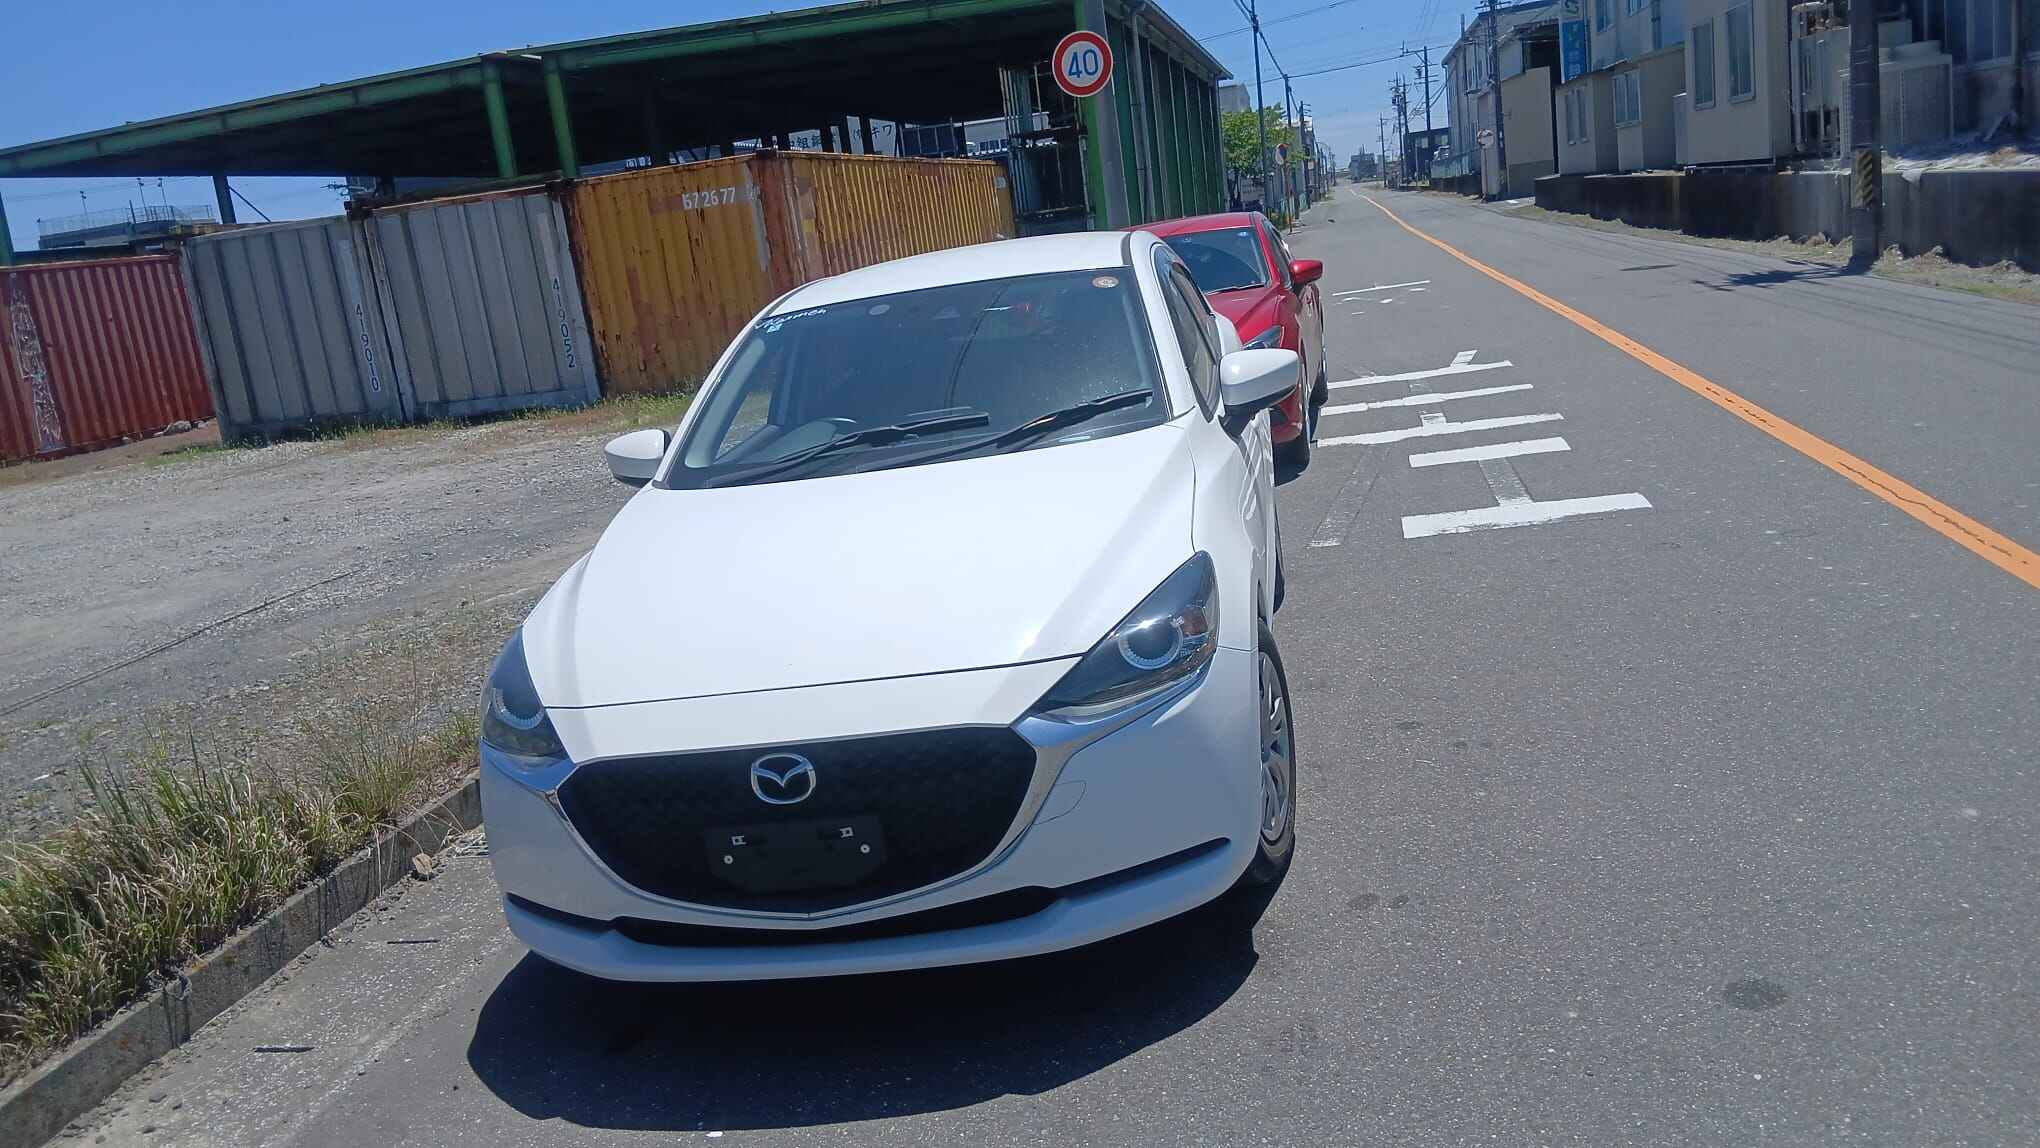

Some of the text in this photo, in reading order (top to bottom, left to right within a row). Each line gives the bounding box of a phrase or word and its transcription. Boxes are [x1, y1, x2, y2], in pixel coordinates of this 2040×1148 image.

[1068, 49, 1099, 79] 40
[356, 303, 379, 391] 419010
[552, 277, 576, 369] 419052
